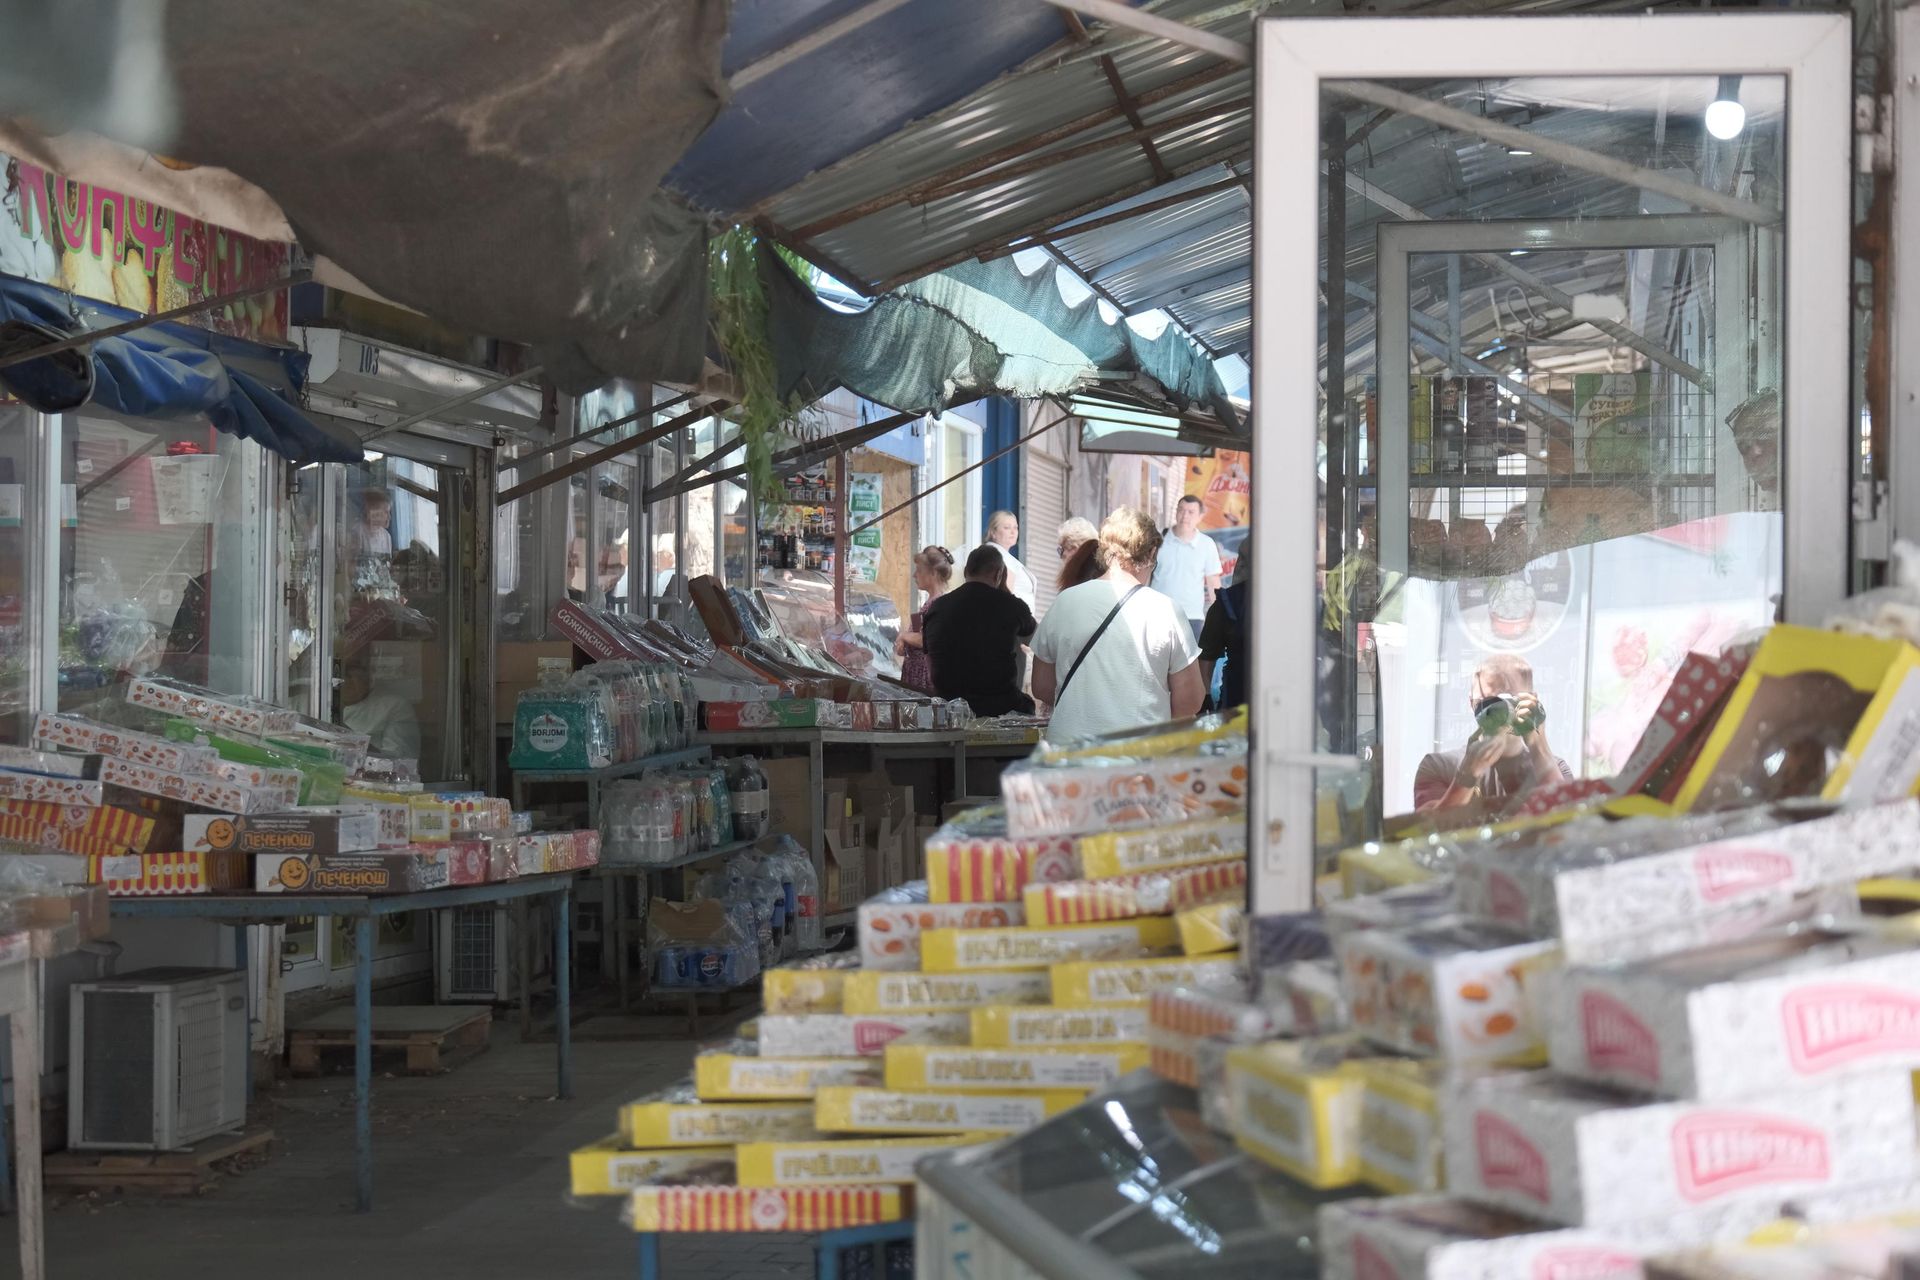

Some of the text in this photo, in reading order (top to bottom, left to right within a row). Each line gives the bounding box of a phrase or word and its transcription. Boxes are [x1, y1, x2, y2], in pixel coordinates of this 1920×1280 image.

[359, 344, 380, 376] 103
[557, 608, 614, 657] Сажинский
[531, 728, 566, 737] BORJOMI
[241, 831, 314, 849] ПЕЧЕНЮШ
[315, 869, 389, 888] ПЕЧЕНЮШ
[932, 1055, 1034, 1082] ПЧЁЛКА
[782, 1152, 882, 1178] ПЧЁЛКА
